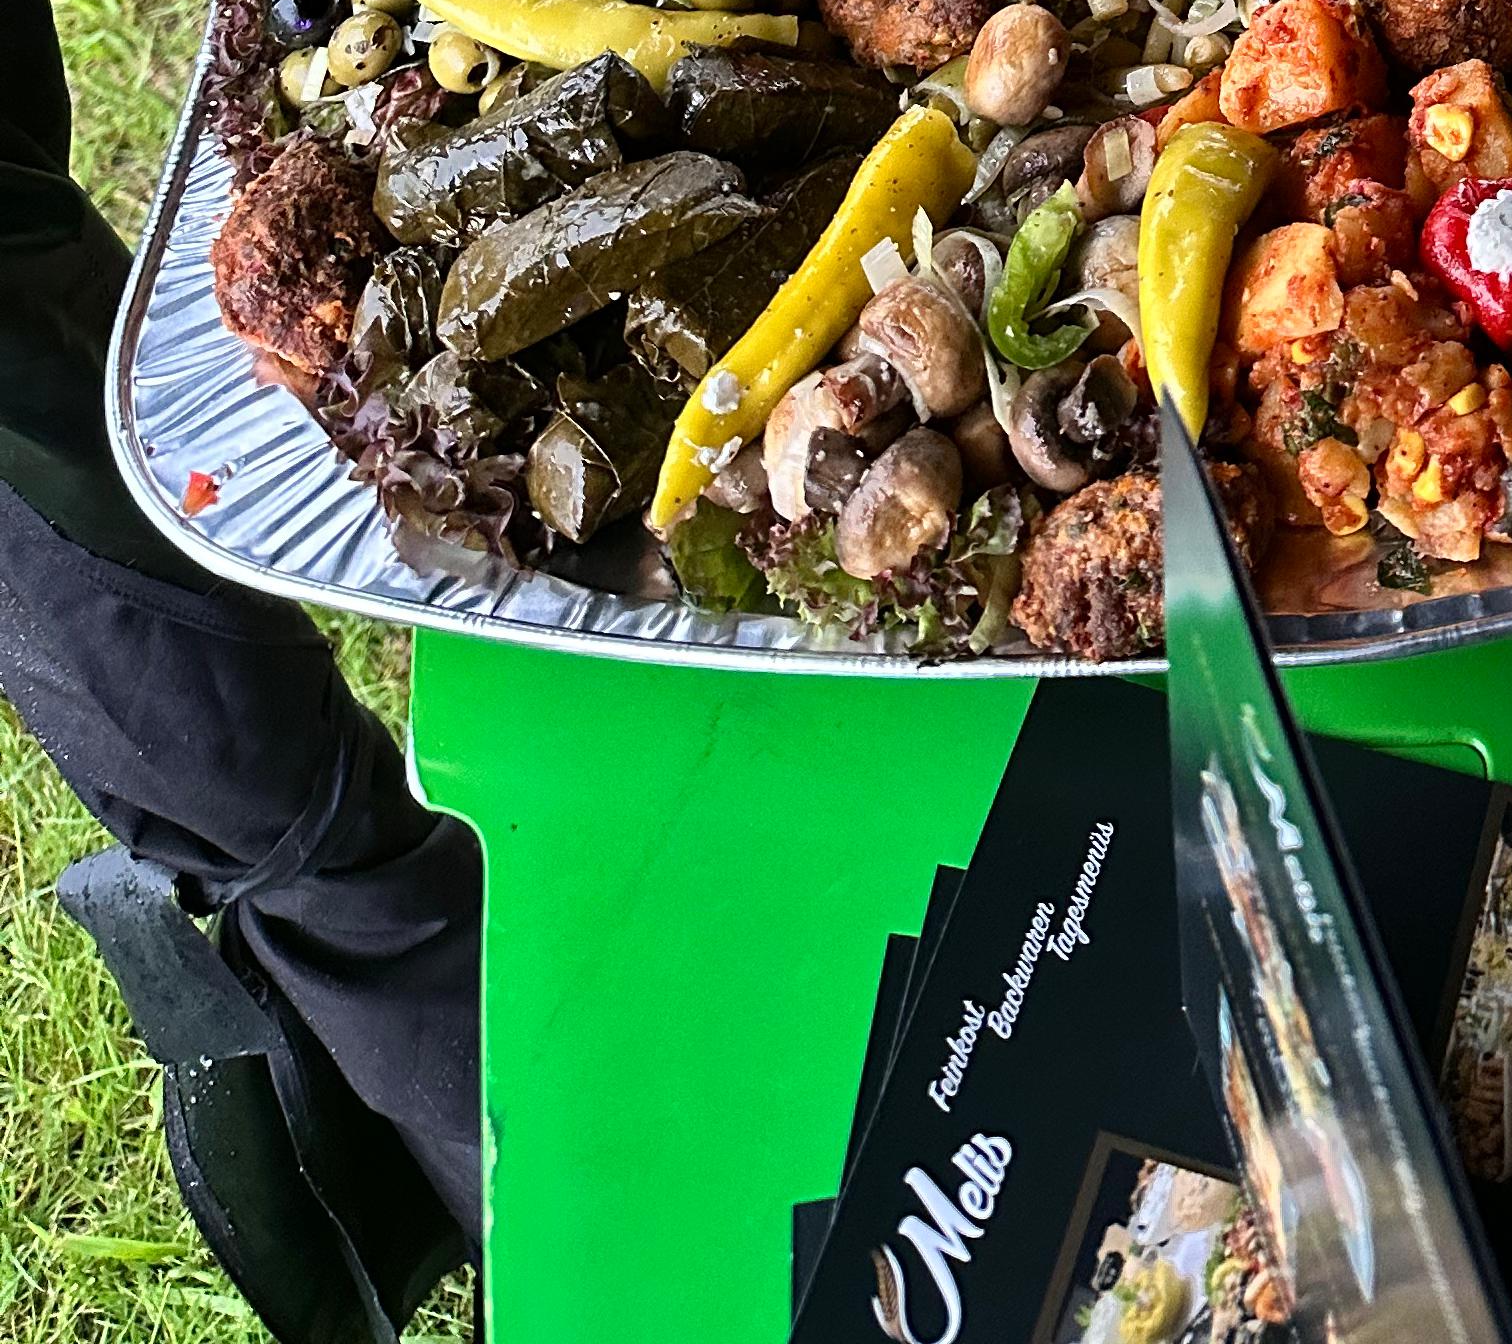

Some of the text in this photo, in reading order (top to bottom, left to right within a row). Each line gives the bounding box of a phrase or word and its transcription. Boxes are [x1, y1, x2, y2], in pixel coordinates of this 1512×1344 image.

[1046, 822, 1114, 961] Tagesmenüs
[987, 902, 1056, 1040] Backwaren
[927, 999, 986, 1112] Feinkost
[880, 1133, 1013, 1344] Melis
